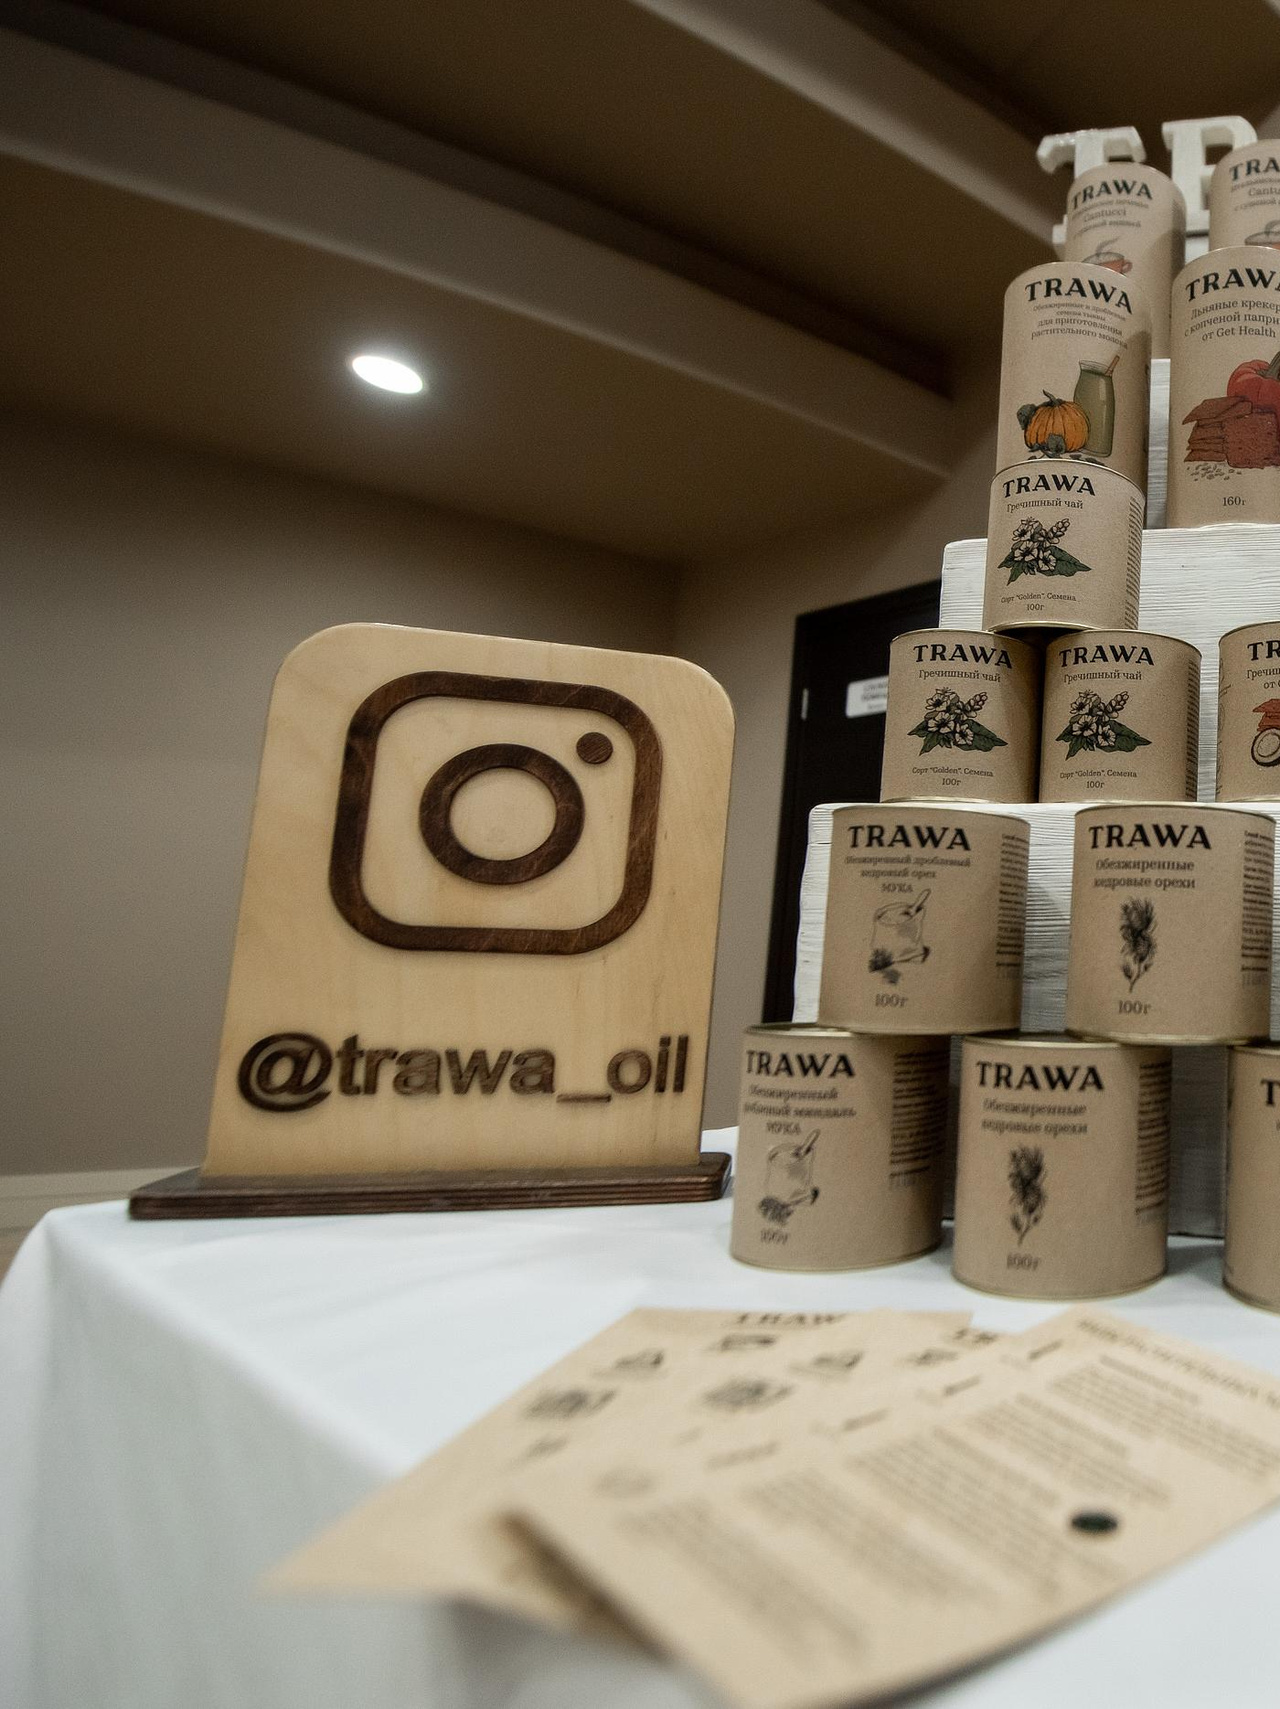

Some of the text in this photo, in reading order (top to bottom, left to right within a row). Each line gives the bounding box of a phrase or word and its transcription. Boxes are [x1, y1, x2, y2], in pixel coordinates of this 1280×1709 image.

[1072, 179, 1152, 209] TRAWA
[1025, 278, 1132, 315] TRAWA
[1190, 299, 1238, 321] Льняные
[1038, 317, 1122, 336] для приготовления
[1190, 311, 1241, 335] копченой
[1031, 327, 1128, 349] растительного молока
[1202, 325, 1276, 342] от Get Health
[1002, 474, 1096, 498] TRAWA
[1006, 498, 1084, 513] Гречишный чай
[1222, 496, 1246, 507] 160г
[1047, 593, 1077, 602] Семена
[1026, 603, 1045, 612] 100г
[913, 643, 1013, 670] TRAWA
[1059, 644, 1154, 668] TRAWA
[918, 668, 1001, 684] Гречишный чай
[1064, 669, 1142, 684] Гречишный чай
[1263, 681, 1276, 689] от
[912, 766, 928, 776] Сорт
[963, 767, 994, 778] Семена
[1107, 769, 1137, 778] Семена
[942, 777, 961, 787] 100г
[1086, 780, 1105, 789] 100г
[848, 825, 971, 851] TRAWA
[1088, 823, 1211, 850] TRAWA
[1093, 876, 1195, 891] кедровые орехи
[1118, 1000, 1151, 1015] 100г
[236, 1031, 690, 1113] @trawa_oil
[746, 1049, 855, 1078] TRAWA
[975, 1060, 1105, 1092] TRAWA
